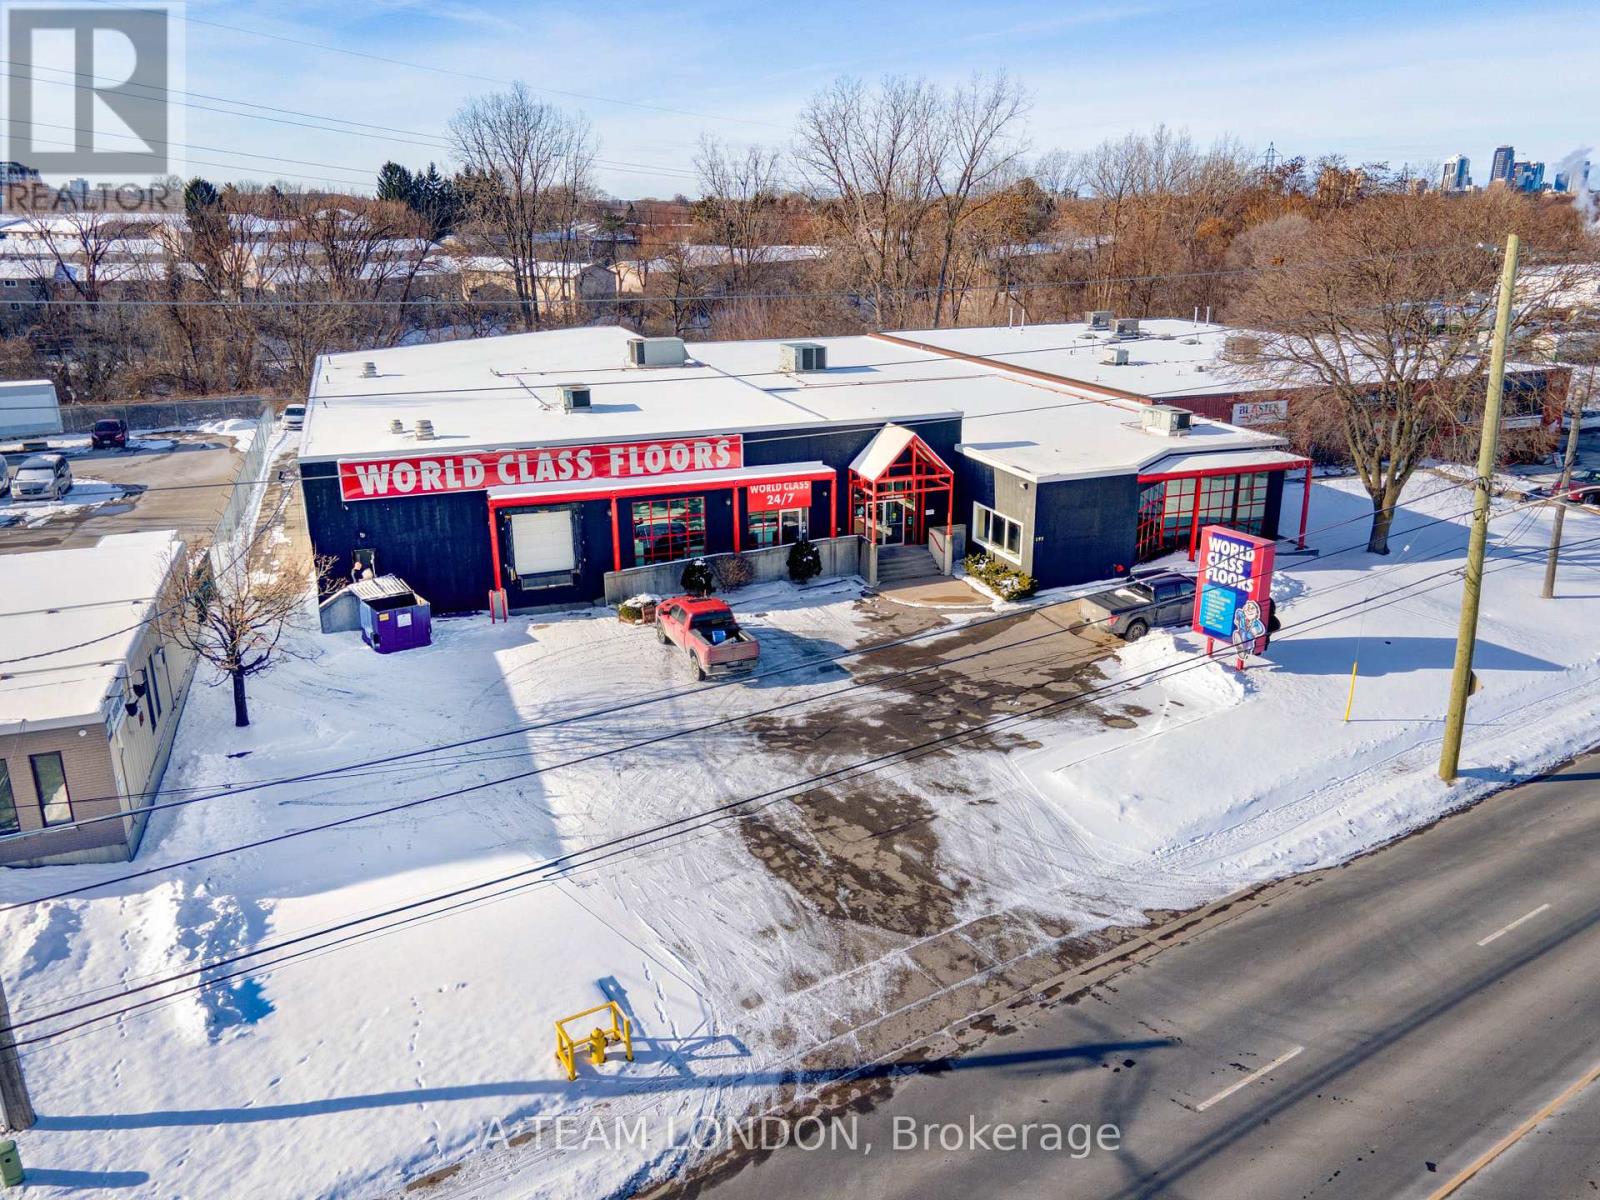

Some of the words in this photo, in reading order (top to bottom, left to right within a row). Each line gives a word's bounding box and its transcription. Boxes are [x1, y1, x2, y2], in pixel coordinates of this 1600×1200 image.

[355, 457, 485, 496] WORLD
[497, 449, 593, 485] CLASS
[609, 439, 731, 477] FLOORS
[750, 483, 782, 494] WORLD
[783, 480, 809, 491] CLASS
[766, 493, 795, 506] 24/7
[1208, 536, 1256, 562] WORLD
[1207, 551, 1244, 574] CLASS
[1205, 565, 1254, 593] FLOORS
